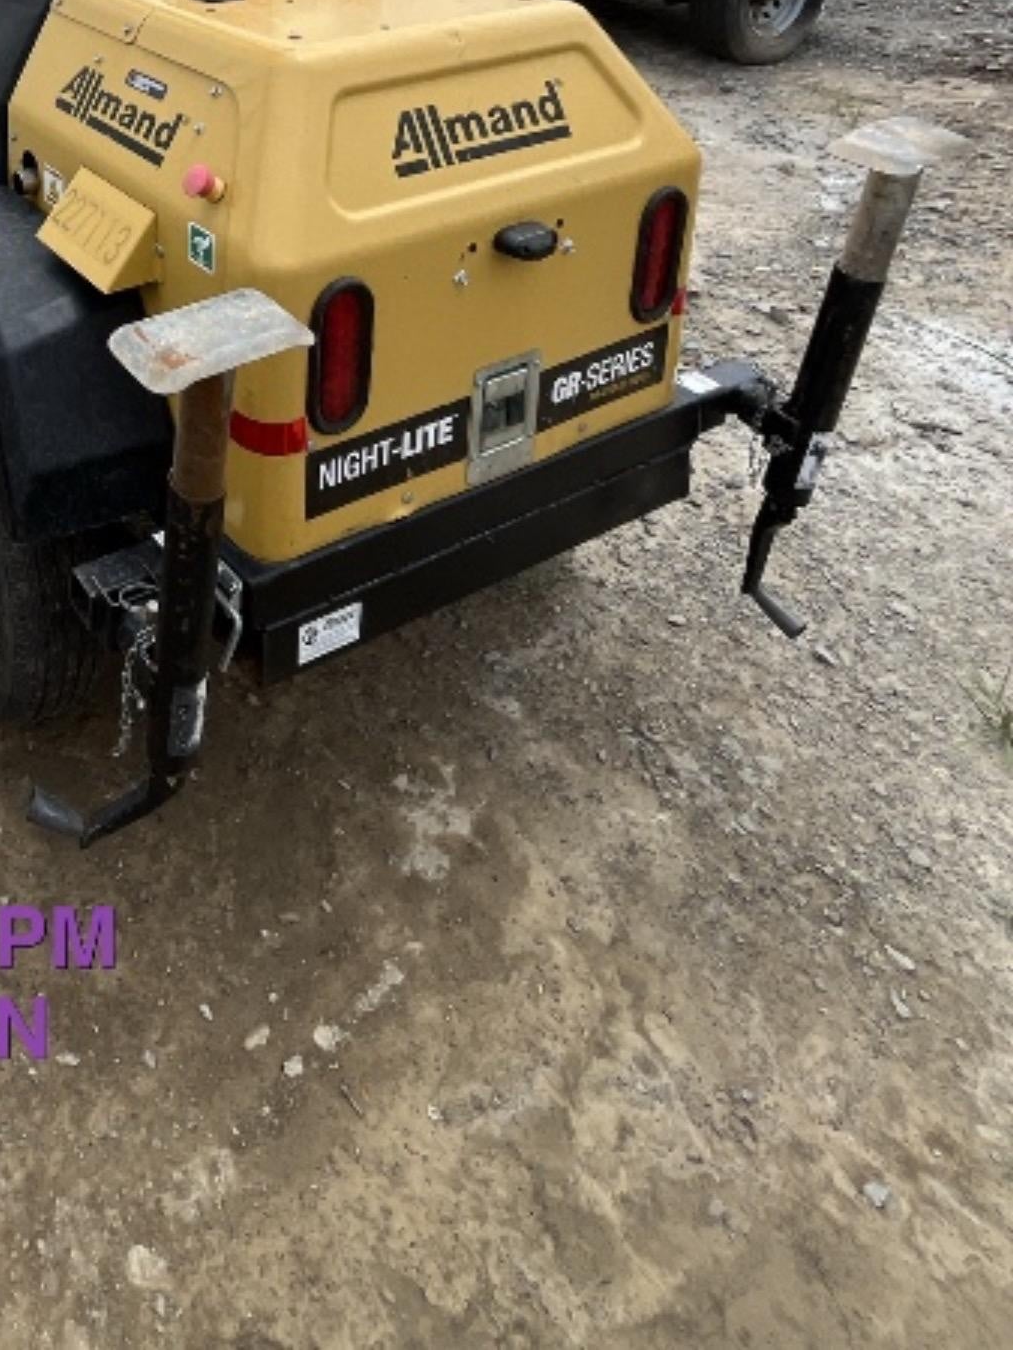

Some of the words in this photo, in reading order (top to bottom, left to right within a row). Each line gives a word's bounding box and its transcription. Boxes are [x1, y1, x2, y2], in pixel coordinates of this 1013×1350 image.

[58, 64, 183, 152] Allmand
[391, 79, 565, 170] Allmand
[550, 340, 655, 404] GR-SERIES
[318, 413, 457, 491] NIGHT-LITE
